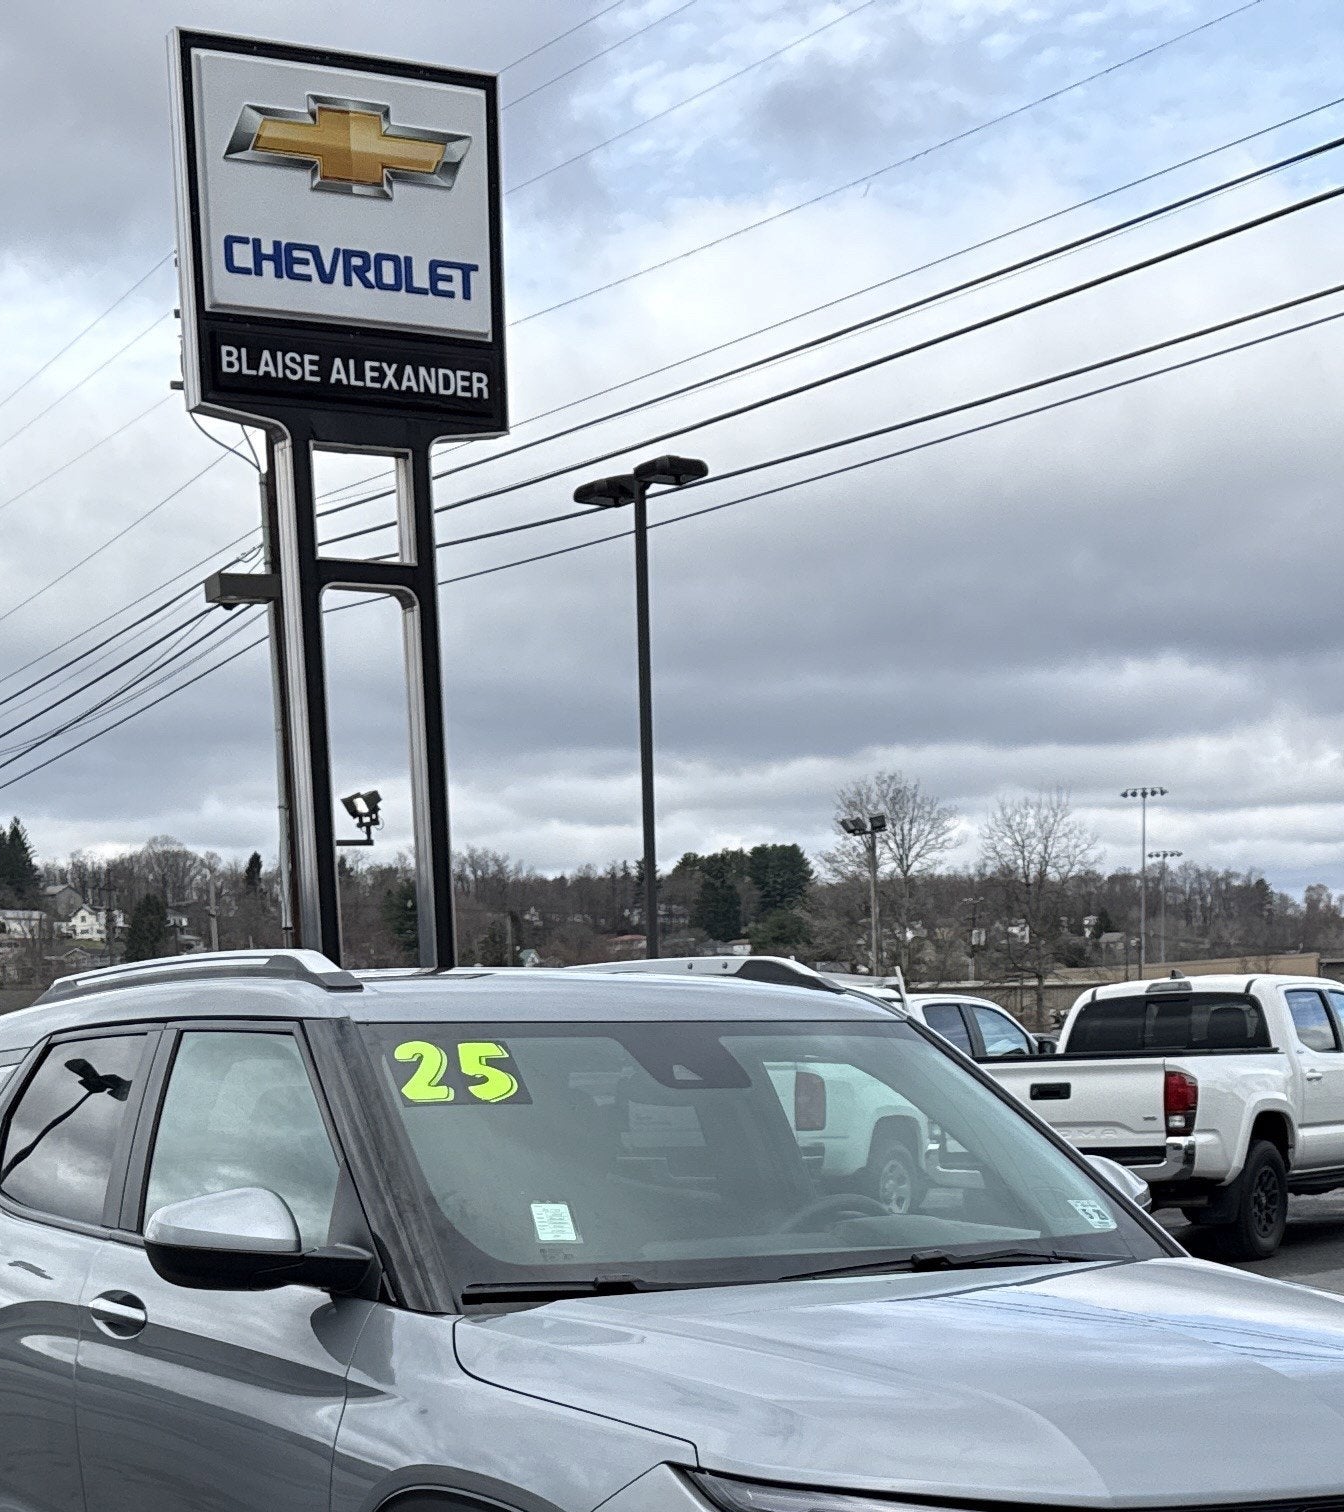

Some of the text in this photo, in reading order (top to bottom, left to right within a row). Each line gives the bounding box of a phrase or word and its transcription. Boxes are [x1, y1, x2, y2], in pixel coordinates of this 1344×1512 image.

[224, 235, 479, 300] CHEVROLET
[221, 345, 489, 400] BLAISE ALEXANDER
[394, 1040, 519, 1103] 25
